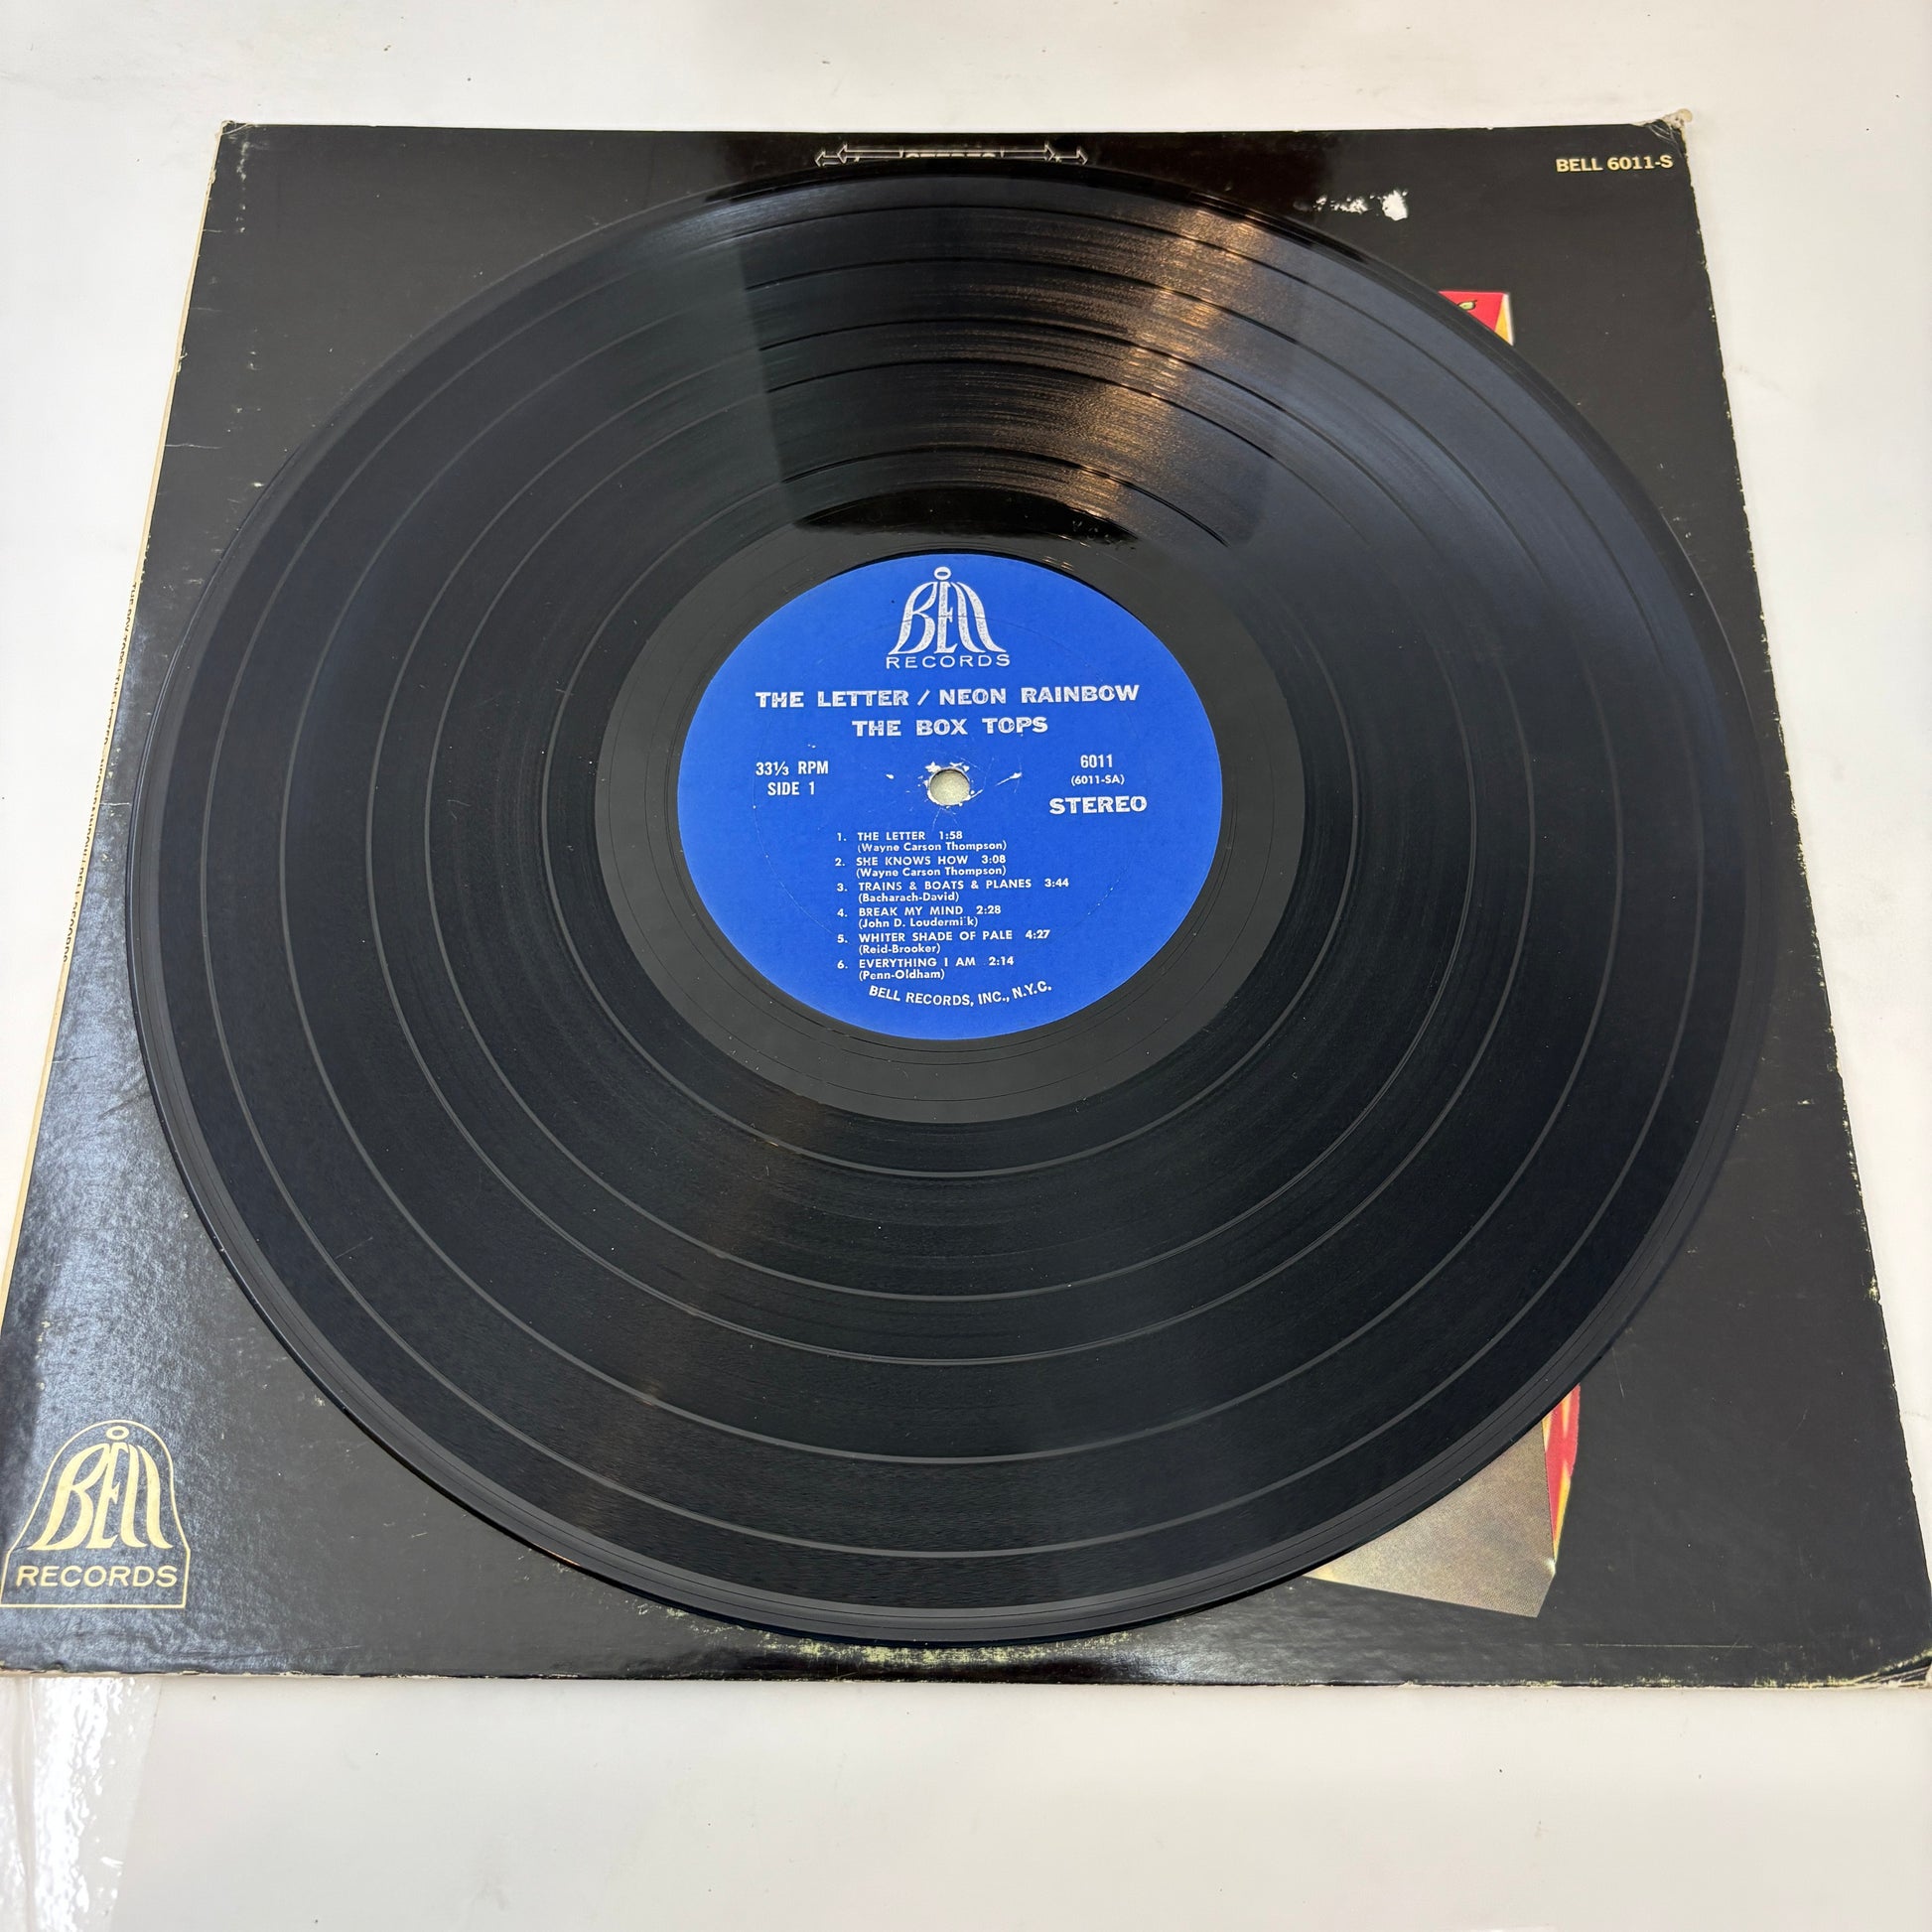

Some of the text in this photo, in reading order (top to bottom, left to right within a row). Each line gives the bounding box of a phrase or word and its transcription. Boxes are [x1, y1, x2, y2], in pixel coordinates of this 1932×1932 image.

[1556, 155, 1673, 172] BELL 6011-S
[886, 654, 1011, 669] RECORDS
[756, 691, 804, 708] THE
[818, 690, 908, 707] LETTER
[939, 688, 1007, 705] NEON
[1021, 684, 1140, 703] RAINBOW
[852, 717, 1048, 737] THE BOX TOPS
[798, 761, 829, 774] RPM
[1080, 755, 1114, 768] 6011
[1071, 774, 1125, 786] (6011-SA)
[767, 782, 815, 796] SIDE 1
[1049, 796, 1148, 815] STEREO
[858, 832, 880, 841] THE
[886, 831, 925, 841] LETTER
[939, 831, 963, 840] 1:58
[858, 841, 1007, 853] (Wayne Carson Thompson)
[856, 857, 879, 866] SHE
[886, 856, 931, 866] KNOWS
[938, 856, 968, 865] HOW
[981, 855, 1006, 864] 3:08
[856, 866, 1007, 879] (Wayne Carson Thompson)
[859, 882, 901, 891] TRAINS
[909, 882, 917, 891] &
[925, 881, 964, 891] BOATS
[970, 880, 979, 890] &
[986, 880, 1032, 889] PLANES
[1044, 879, 1069, 888] 3:44
[858, 892, 959, 902] (Bacharach-David)
[837, 905, 1002, 917] 4. BREAK MY MIND 2:28
[858, 916, 978, 928] (John D. Loudermik)
[859, 932, 904, 942] WHITER
[912, 932, 953, 941] SHADE
[960, 931, 976, 940] OF
[983, 930, 1013, 940] PALE
[1026, 929, 1050, 939] 4:27
[858, 943, 940, 955] (Reid-Brooker)
[837, 956, 1014, 969] 6. EVERYTHING I AM 2:14
[858, 969, 945, 981] (Penn-Oldham)
[868, 980, 1052, 1007] BELL RECORDS, INC., N.Y.C.
[15, 1565, 177, 1587] RECORDS
